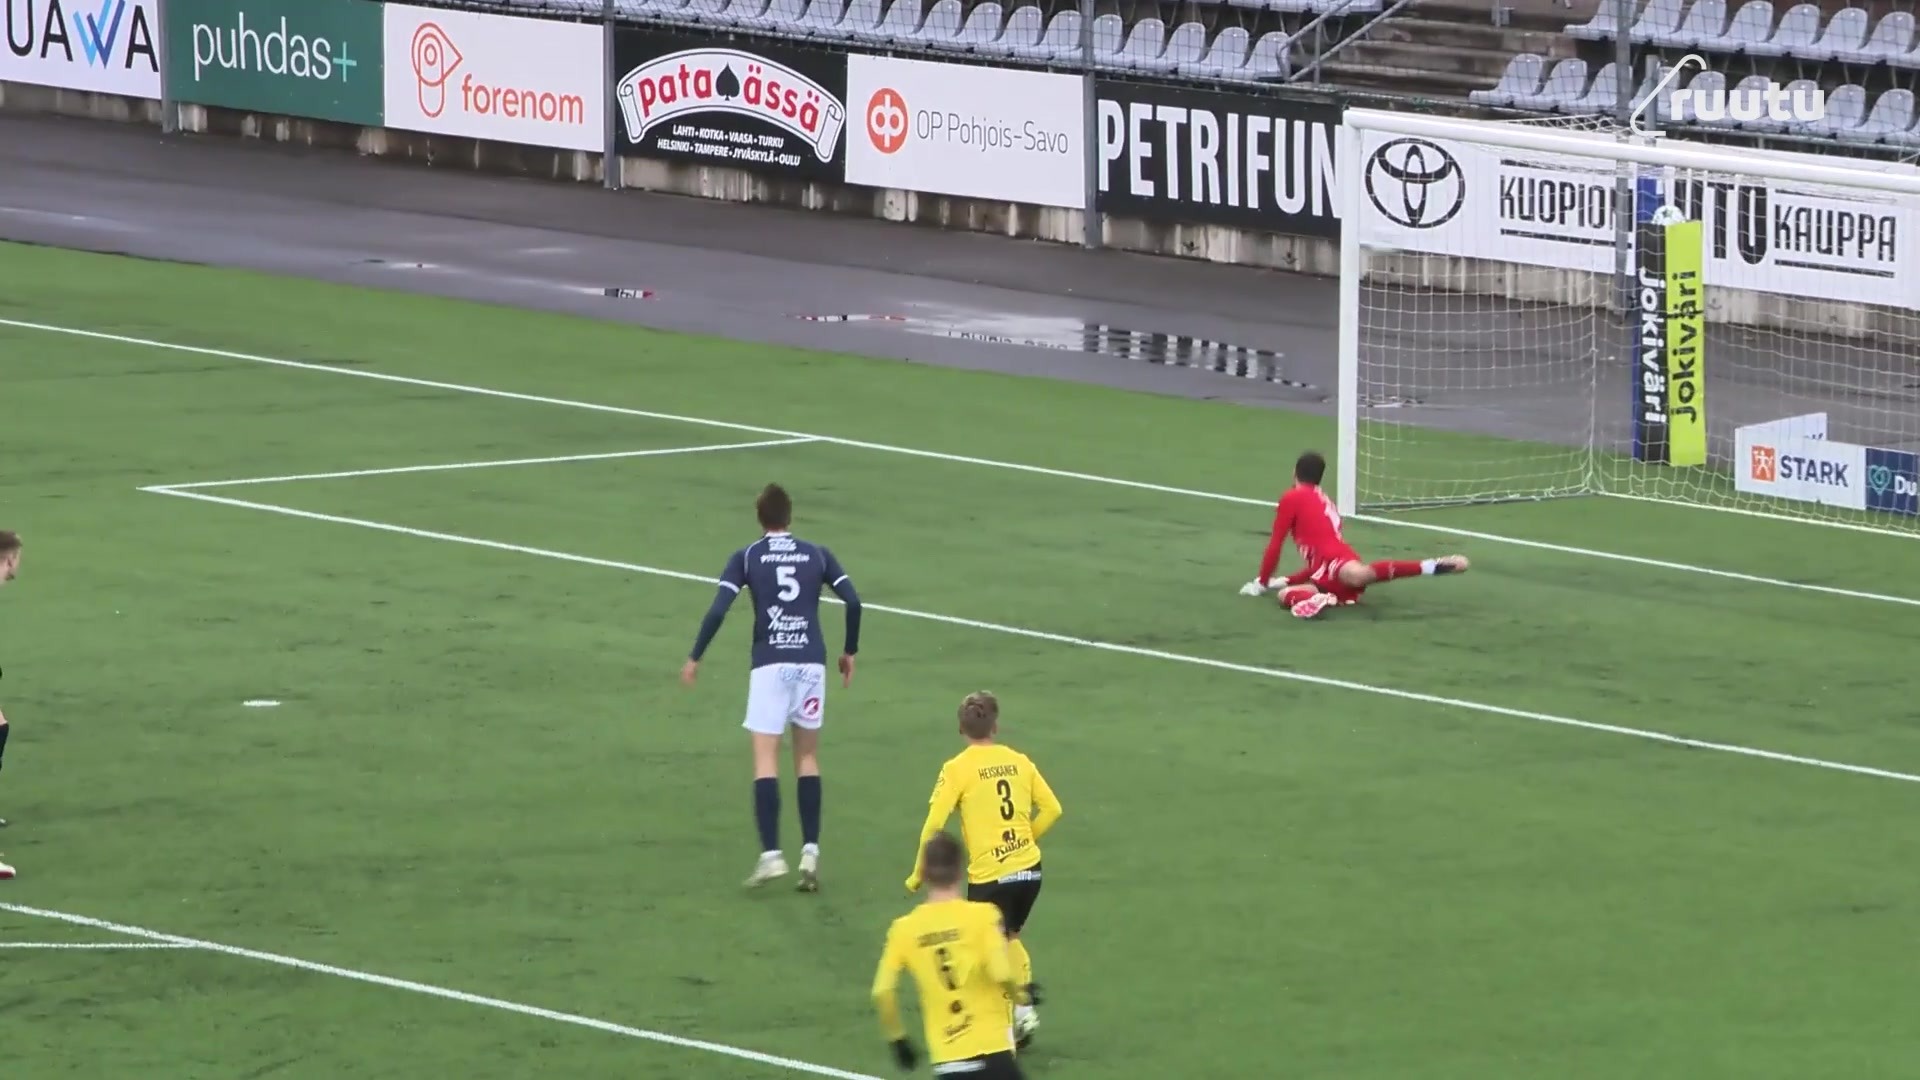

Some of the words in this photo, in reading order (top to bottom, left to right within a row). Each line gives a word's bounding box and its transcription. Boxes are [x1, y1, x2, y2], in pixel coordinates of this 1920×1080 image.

[462, 73, 584, 125] forenom
[638, 63, 712, 118] pata
[743, 64, 820, 132] ässä
[673, 125, 695, 137] LAHTI
[700, 128, 724, 141] KOTKA
[729, 131, 753, 144] VAASA
[758, 135, 784, 148] TURKU
[916, 110, 943, 140] OP
[947, 112, 1069, 154] Pohjois-Savo
[657, 138, 690, 152] HELSINKI
[695, 143, 729, 157] TAMPERE
[732, 147, 774, 163] JYVÄSKYLÄ
[779, 154, 801, 166] OULU
[1774, 203, 1896, 262] KAUPPA
[1780, 455, 1849, 487] STARK
[776, 565, 801, 602] 5
[978, 765, 1019, 780] HEISKANEN
[996, 779, 1015, 821] 3
